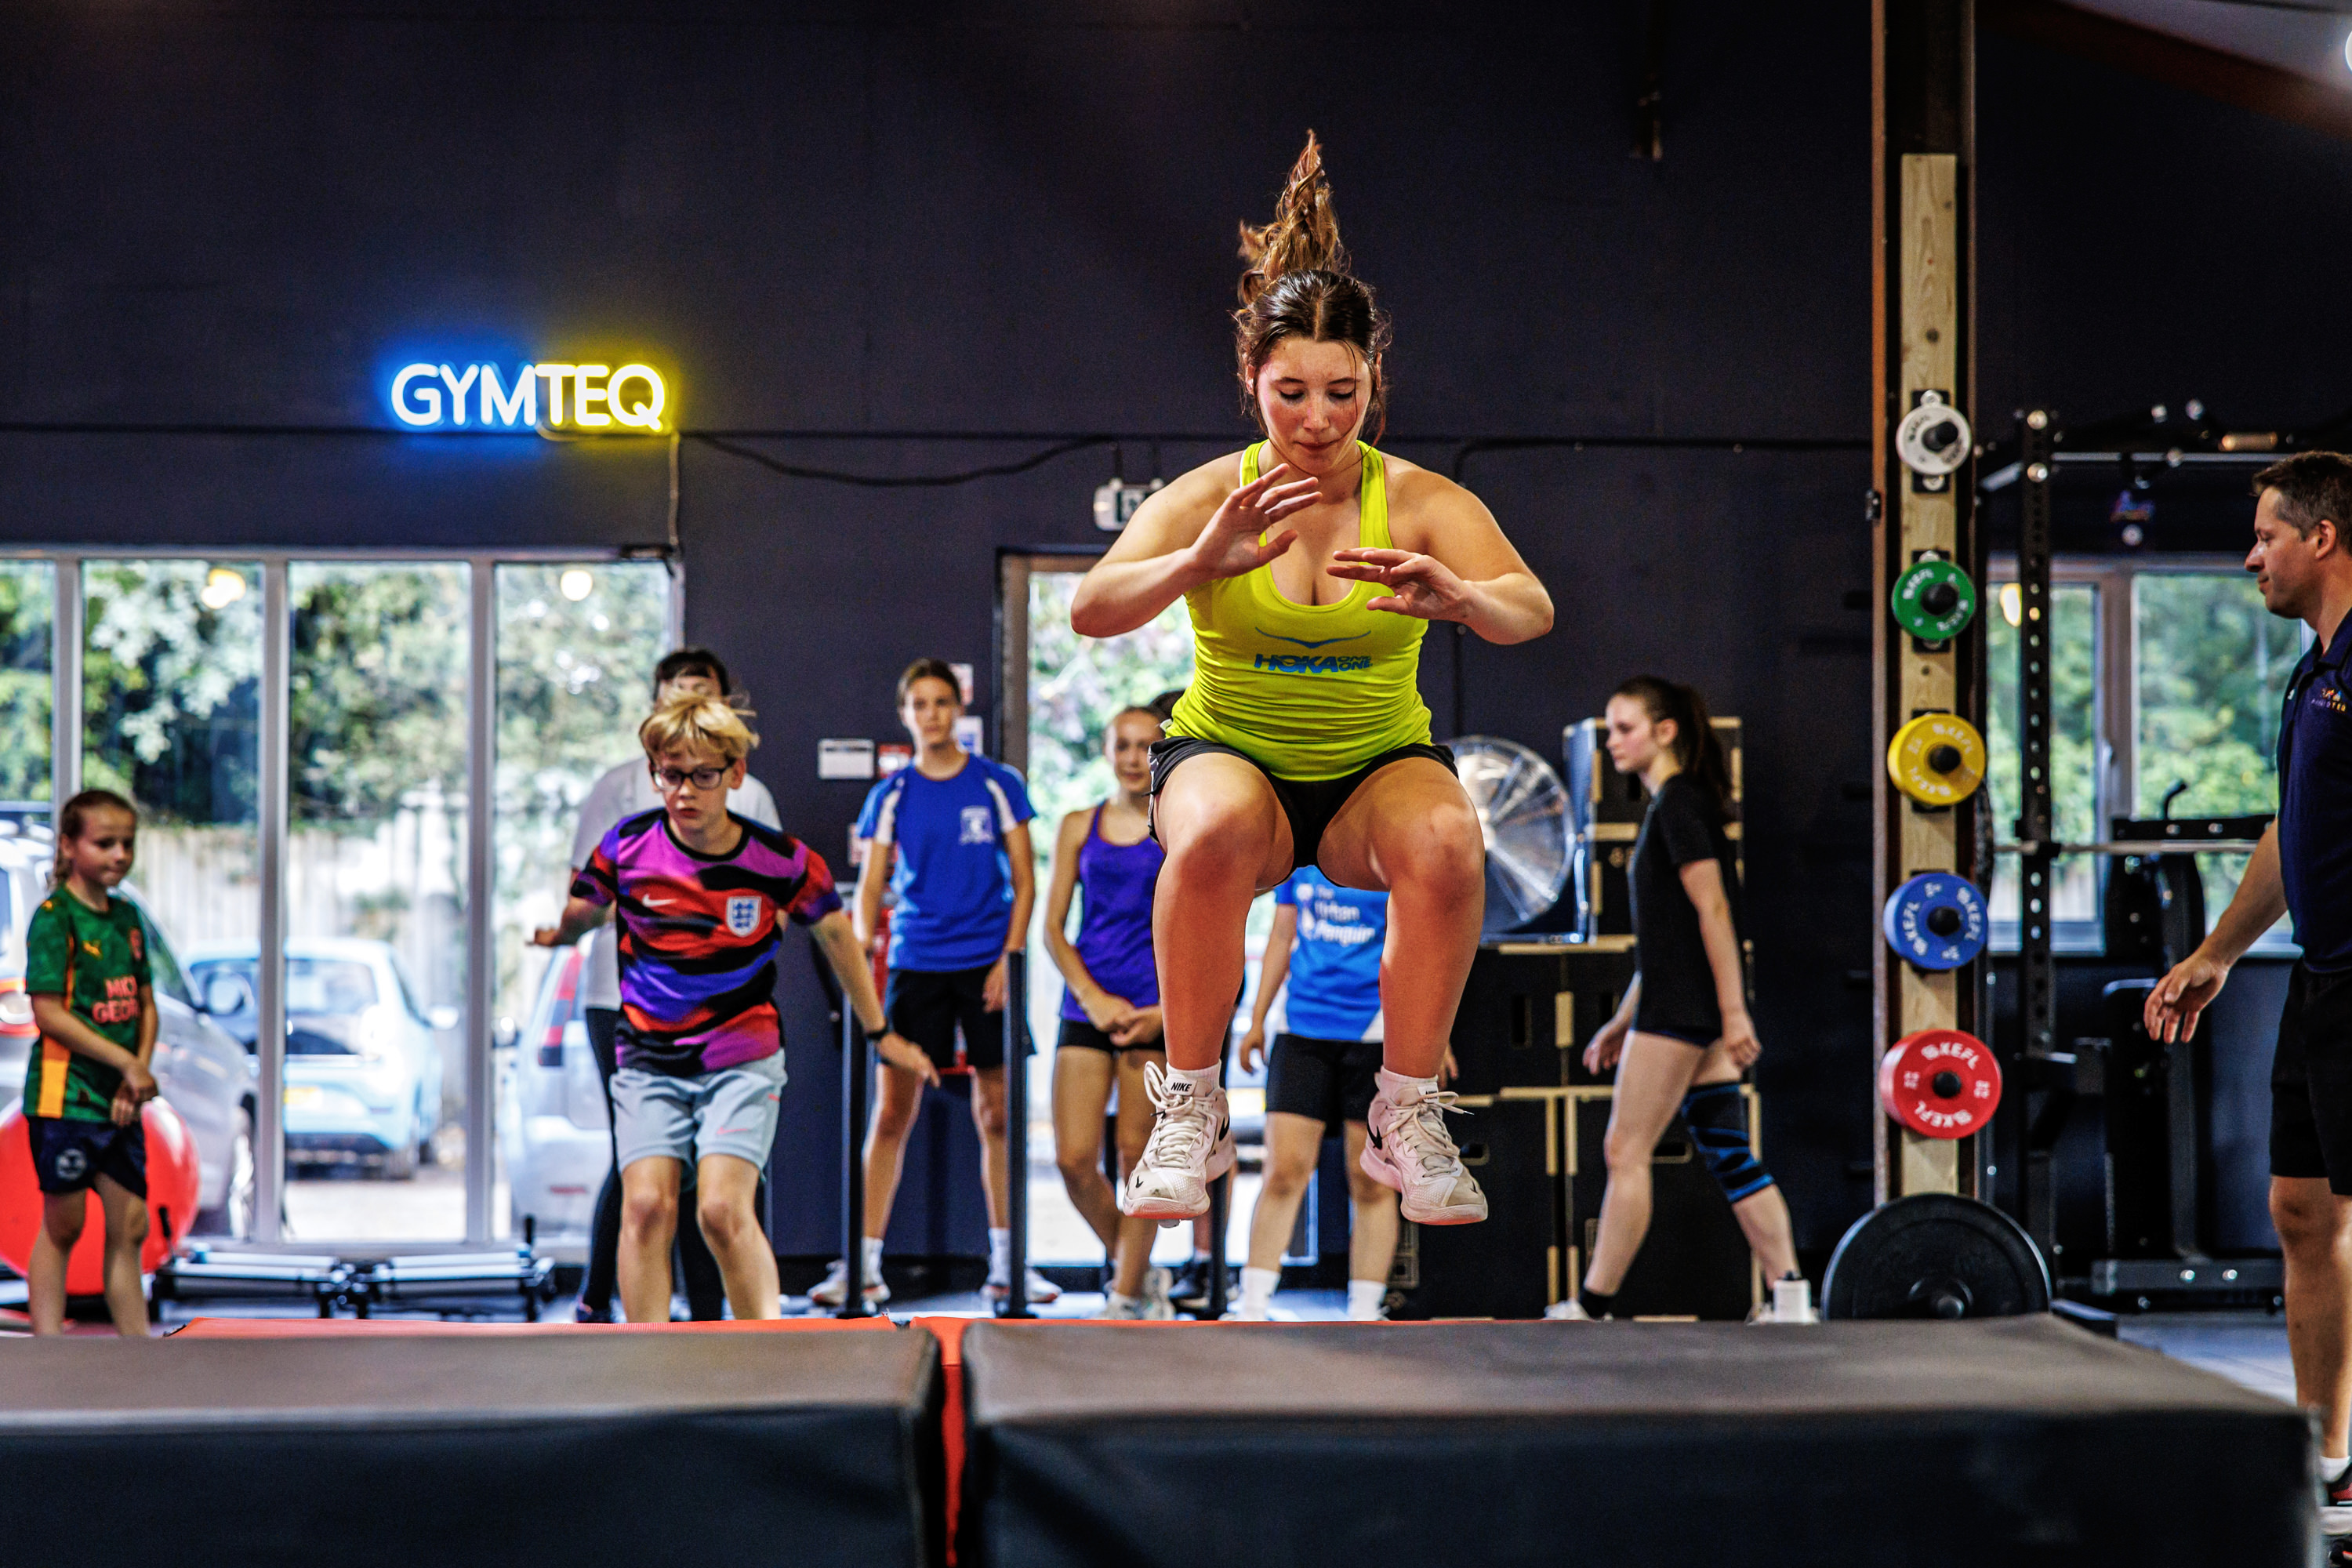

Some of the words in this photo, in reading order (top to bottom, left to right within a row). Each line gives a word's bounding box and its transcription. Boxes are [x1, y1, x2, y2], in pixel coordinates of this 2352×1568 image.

[391, 363, 666, 432] GYMTEQ
[1254, 654, 1338, 673] HOKA
[1338, 661, 1371, 672] ONE
[1171, 1082, 1192, 1091] NIKE
